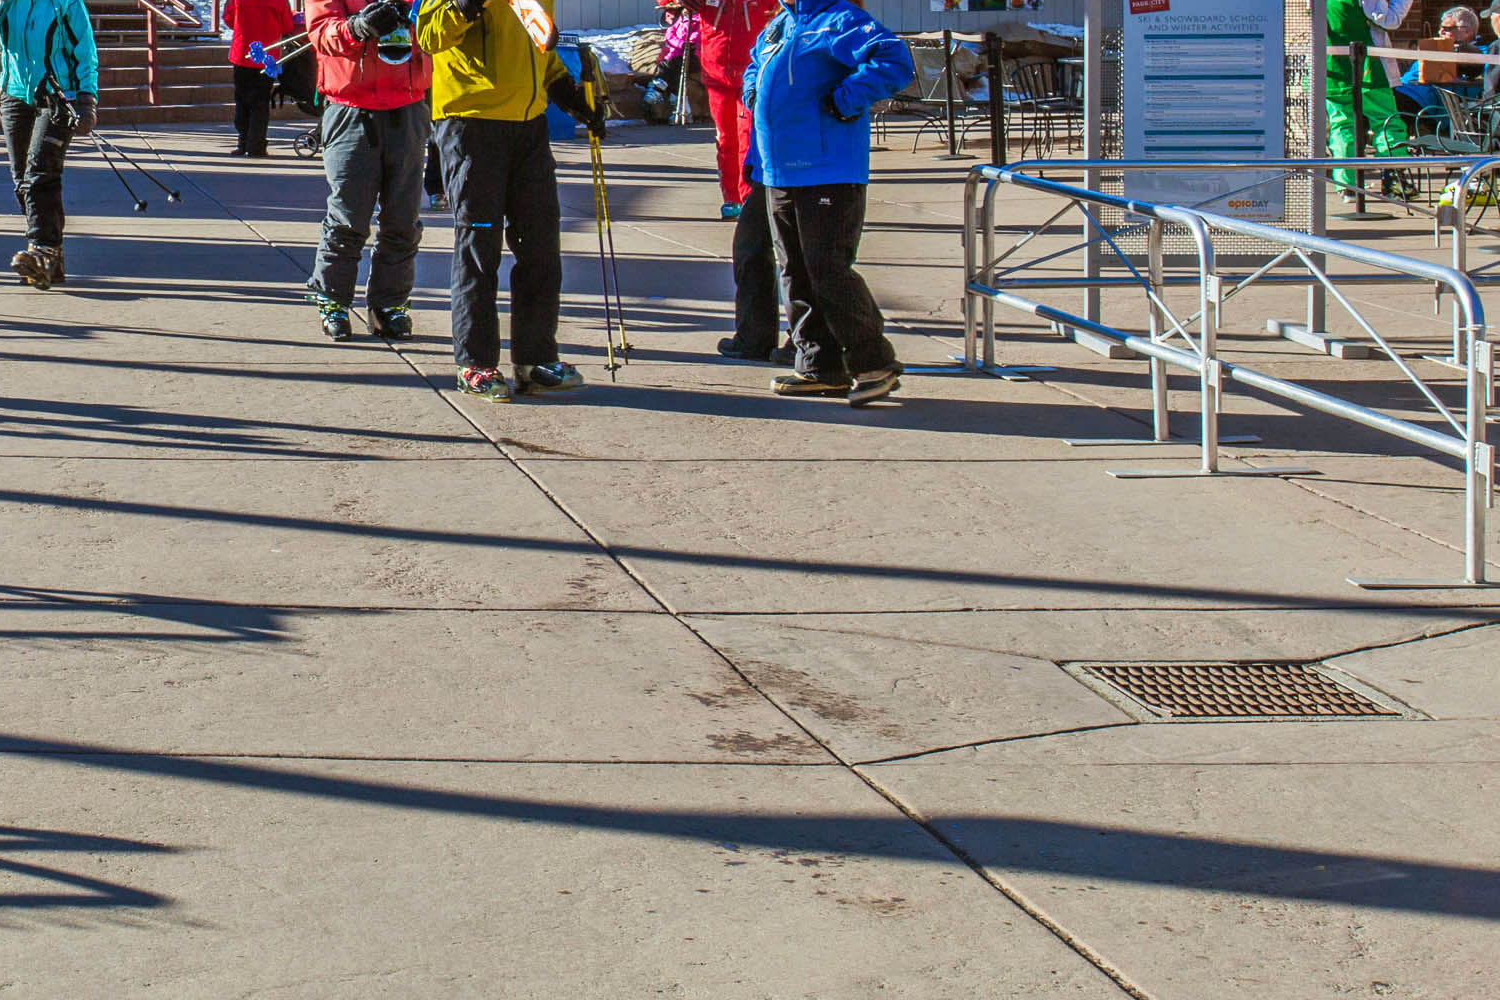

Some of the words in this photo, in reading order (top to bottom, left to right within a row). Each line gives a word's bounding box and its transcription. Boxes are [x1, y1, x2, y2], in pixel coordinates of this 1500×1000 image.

[1165, 15, 1226, 23] SNOWBOARD
[1229, 15, 1268, 23] SCHOOL
[1171, 24, 1207, 32] WINTER
[1211, 23, 1260, 32] ACTIVITIES
